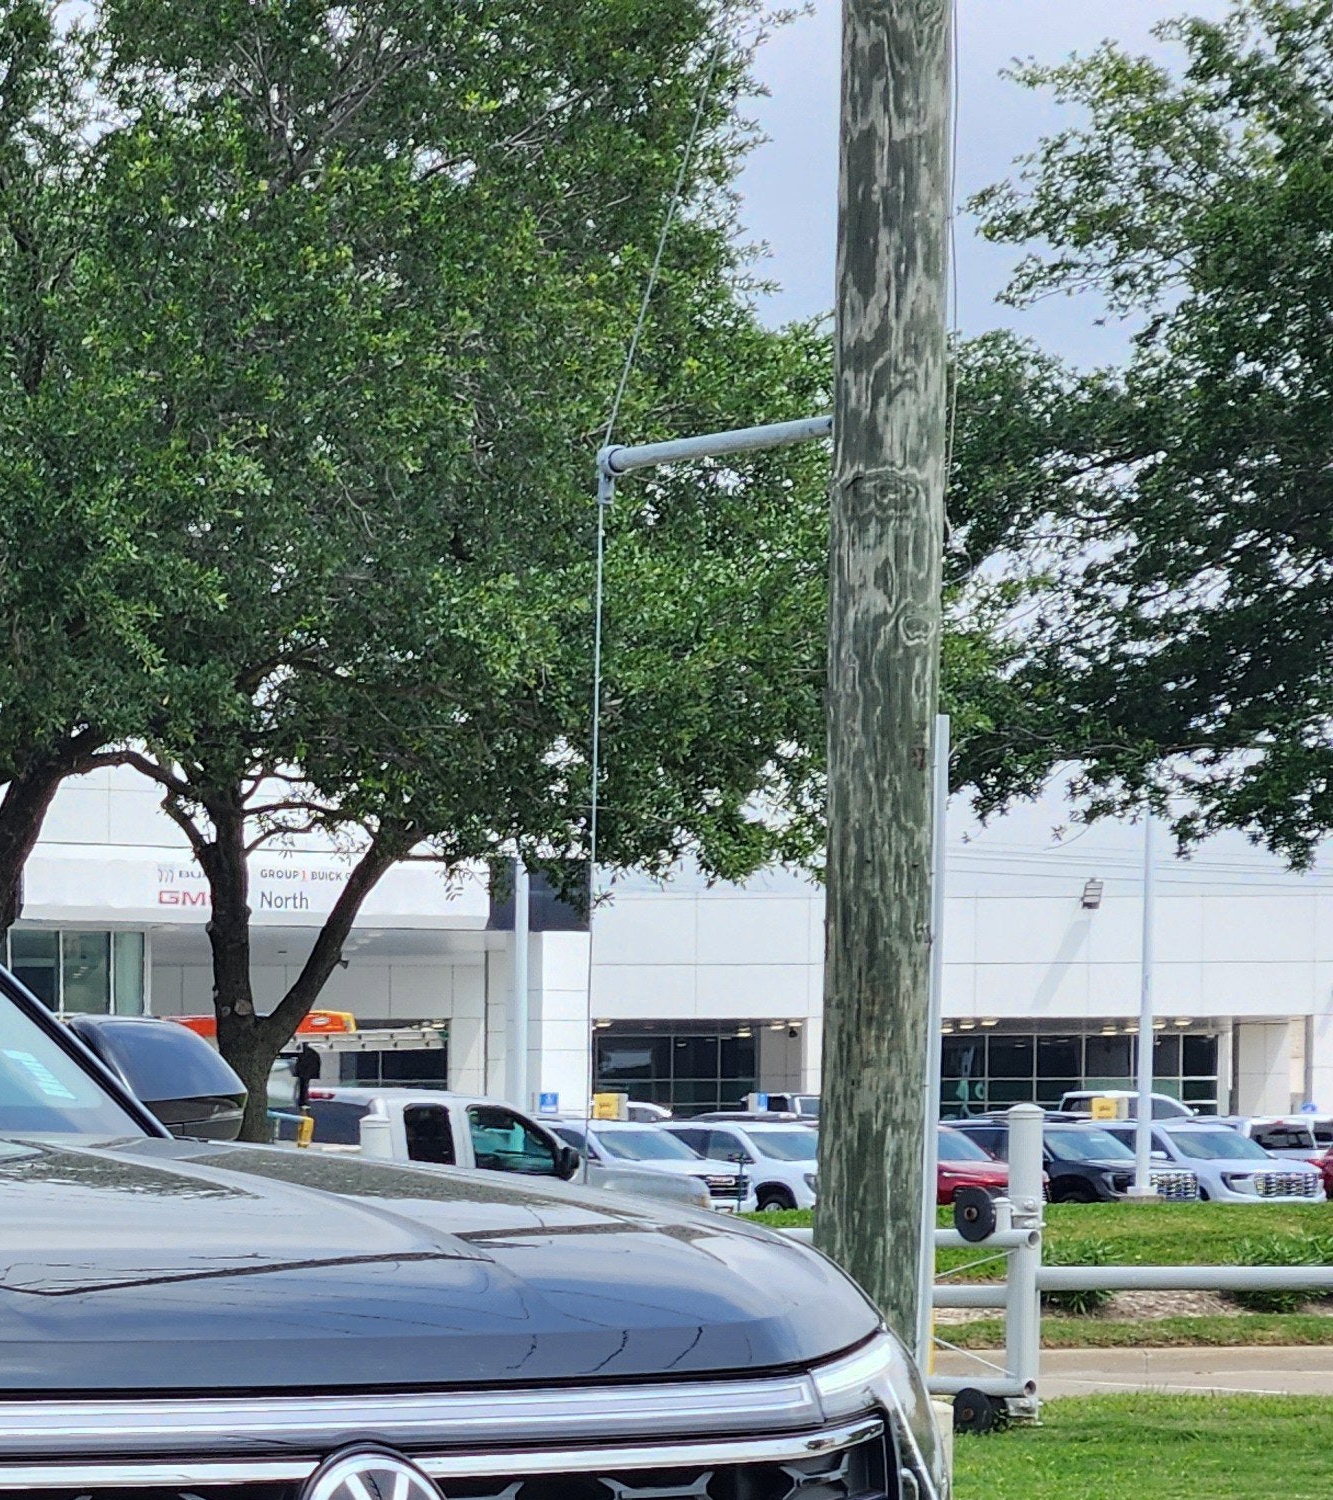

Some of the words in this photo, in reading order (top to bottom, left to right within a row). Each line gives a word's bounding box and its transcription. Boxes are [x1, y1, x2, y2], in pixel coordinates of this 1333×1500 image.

[311, 871, 342, 881] BUICK
[159, 890, 206, 906] GM
[259, 890, 309, 909] North
